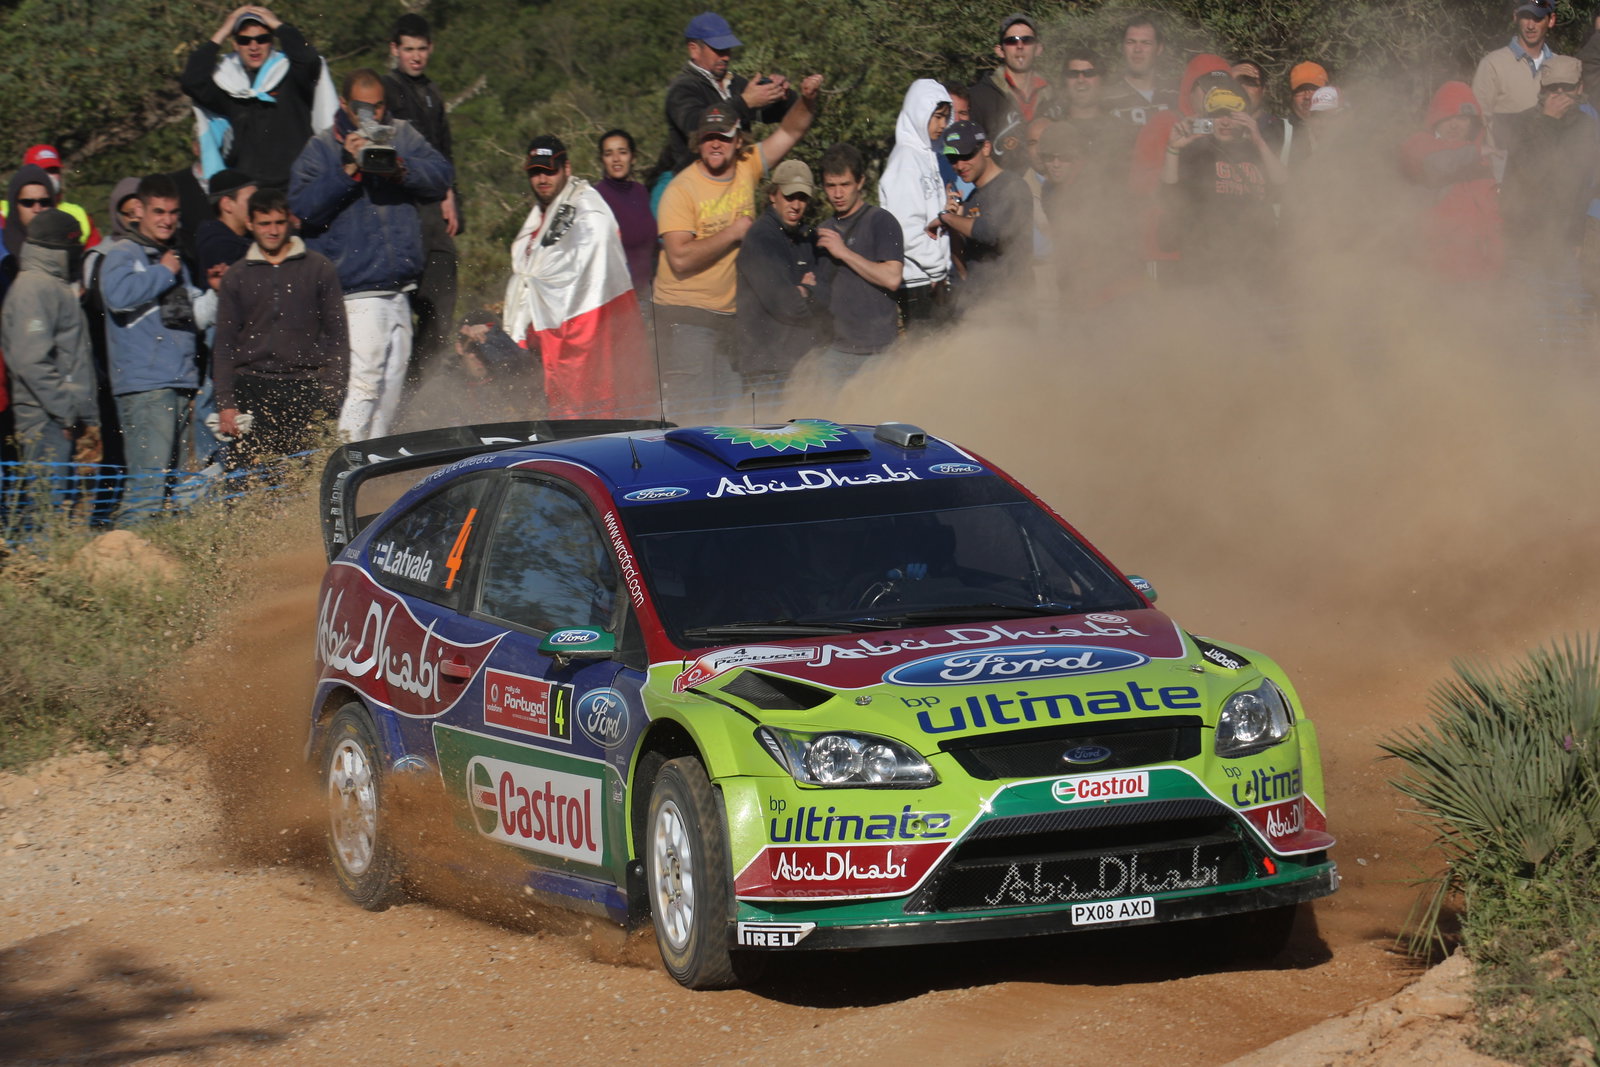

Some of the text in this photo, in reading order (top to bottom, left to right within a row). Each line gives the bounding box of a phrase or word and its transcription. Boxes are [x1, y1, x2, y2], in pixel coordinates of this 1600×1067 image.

[797, 464, 923, 490] Dhabi
[939, 464, 974, 474] Ford
[636, 488, 677, 499] Ford
[383, 541, 433, 582] Latvala
[445, 508, 477, 589] 4
[604, 511, 645, 608] www.wrcford.com
[557, 631, 590, 642] Ford
[945, 620, 1150, 648] Dhabi
[352, 600, 443, 702] Dhabi
[714, 652, 809, 669] Portugal
[734, 648, 747, 656] 4
[939, 649, 1102, 682] Ford
[504, 693, 546, 716] Portugal
[555, 690, 565, 735] 4
[900, 695, 941, 709] bp
[916, 681, 1201, 734] ultimate
[587, 696, 622, 739] Ford
[1075, 748, 1100, 759] Ford
[1222, 765, 1242, 779] bp
[1077, 775, 1144, 798] Castrol
[499, 771, 597, 852] Castrol
[770, 796, 786, 814] bp
[770, 805, 951, 842] ultimate
[823, 849, 907, 880] Dhabi
[1075, 900, 1152, 922] PX08 AXD
